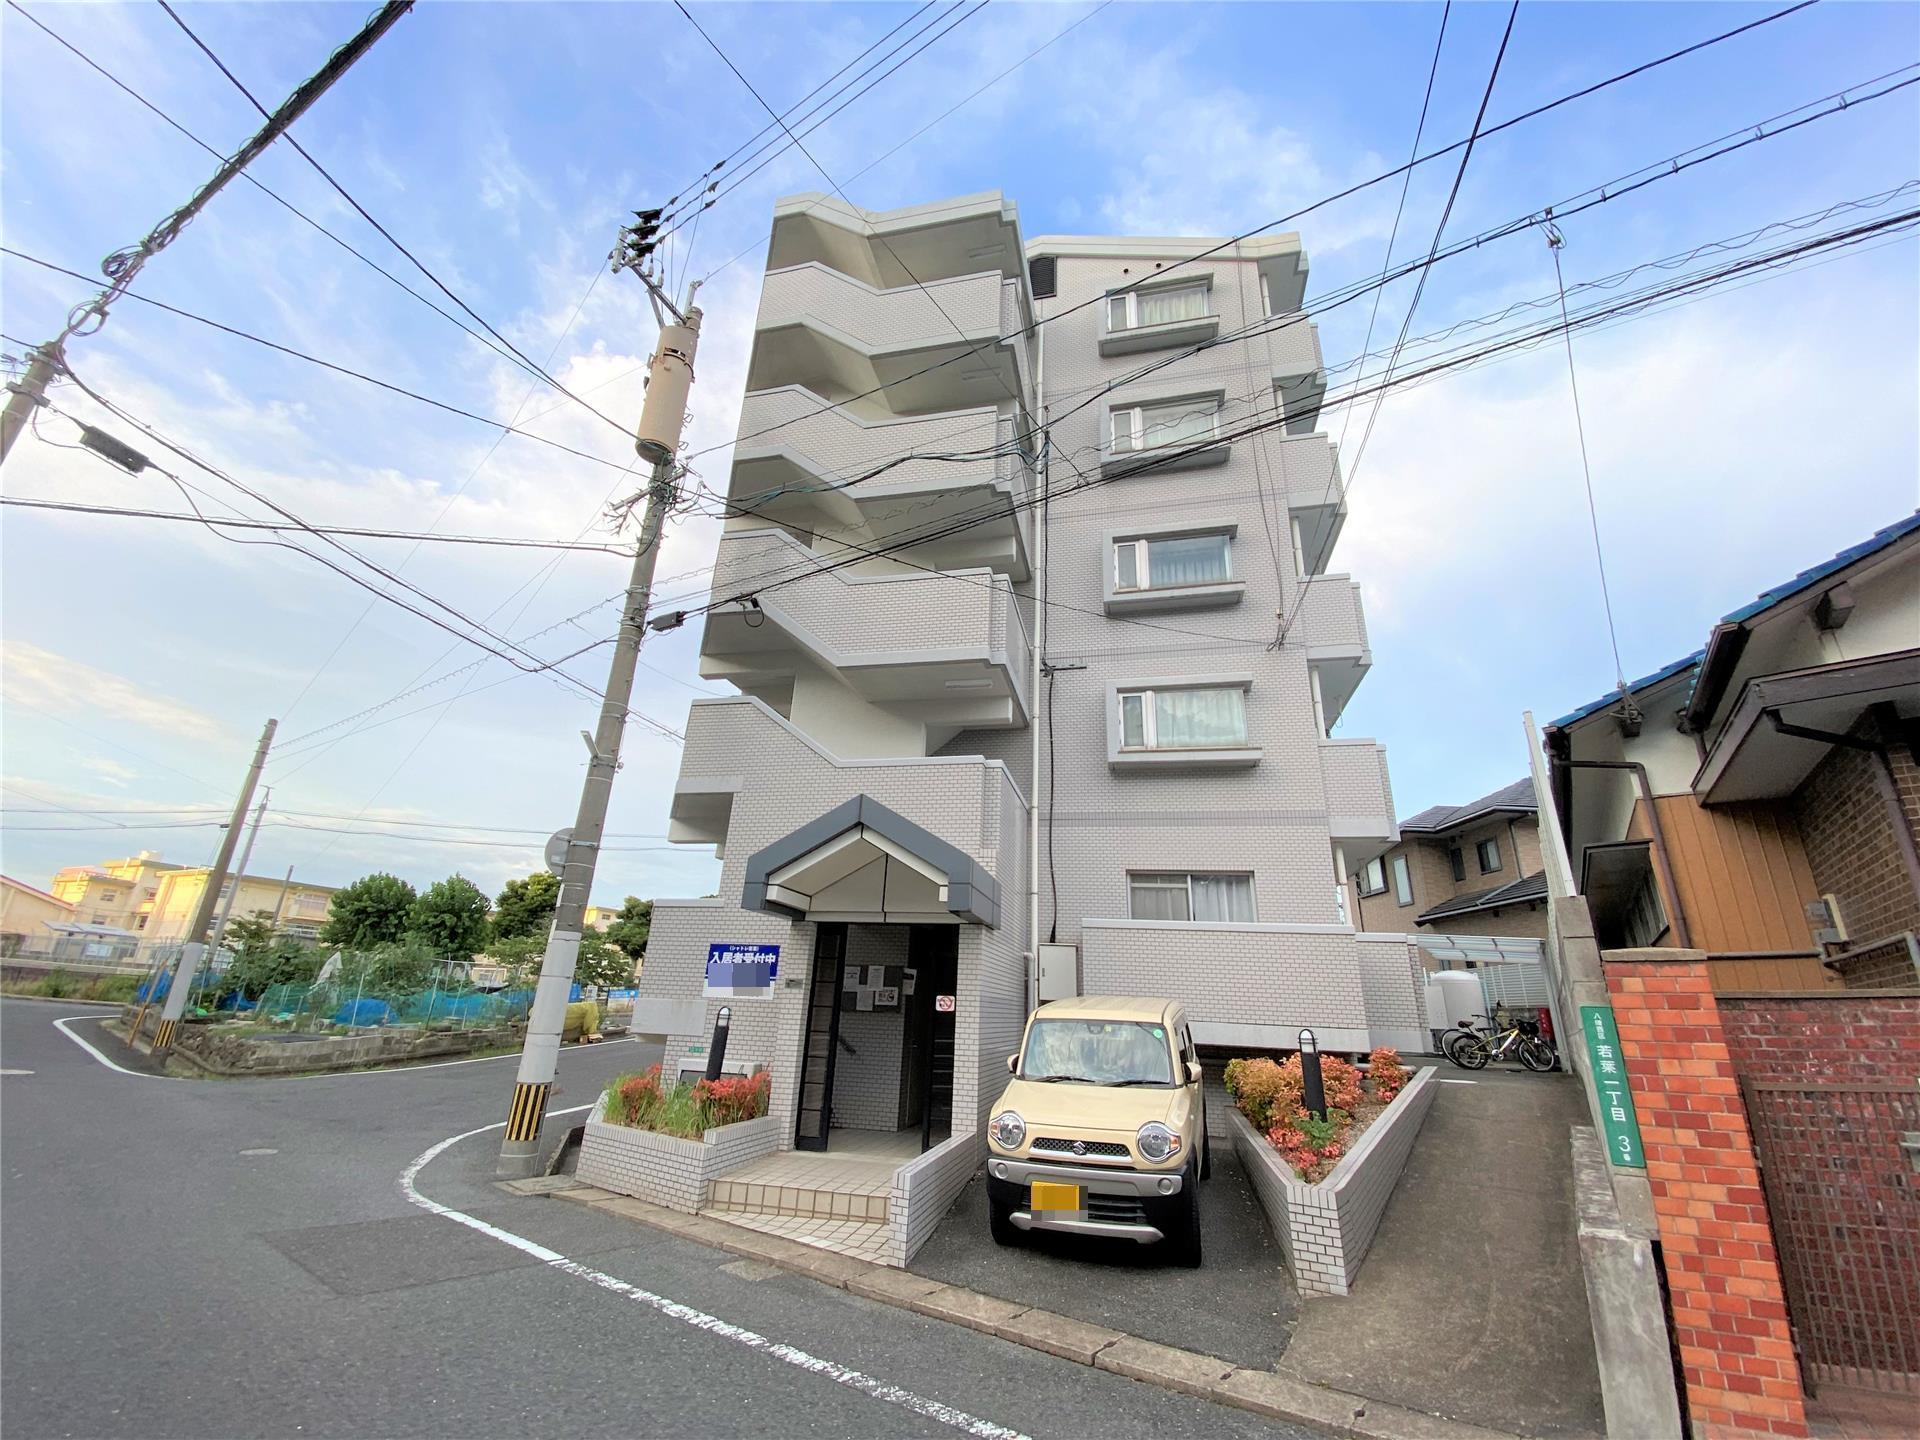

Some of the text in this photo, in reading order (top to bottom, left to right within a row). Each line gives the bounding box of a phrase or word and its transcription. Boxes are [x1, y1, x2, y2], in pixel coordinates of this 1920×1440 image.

[709, 951, 776, 964] 入居者受付中
[1596, 1044, 1626, 1122] 若葉一丁目
